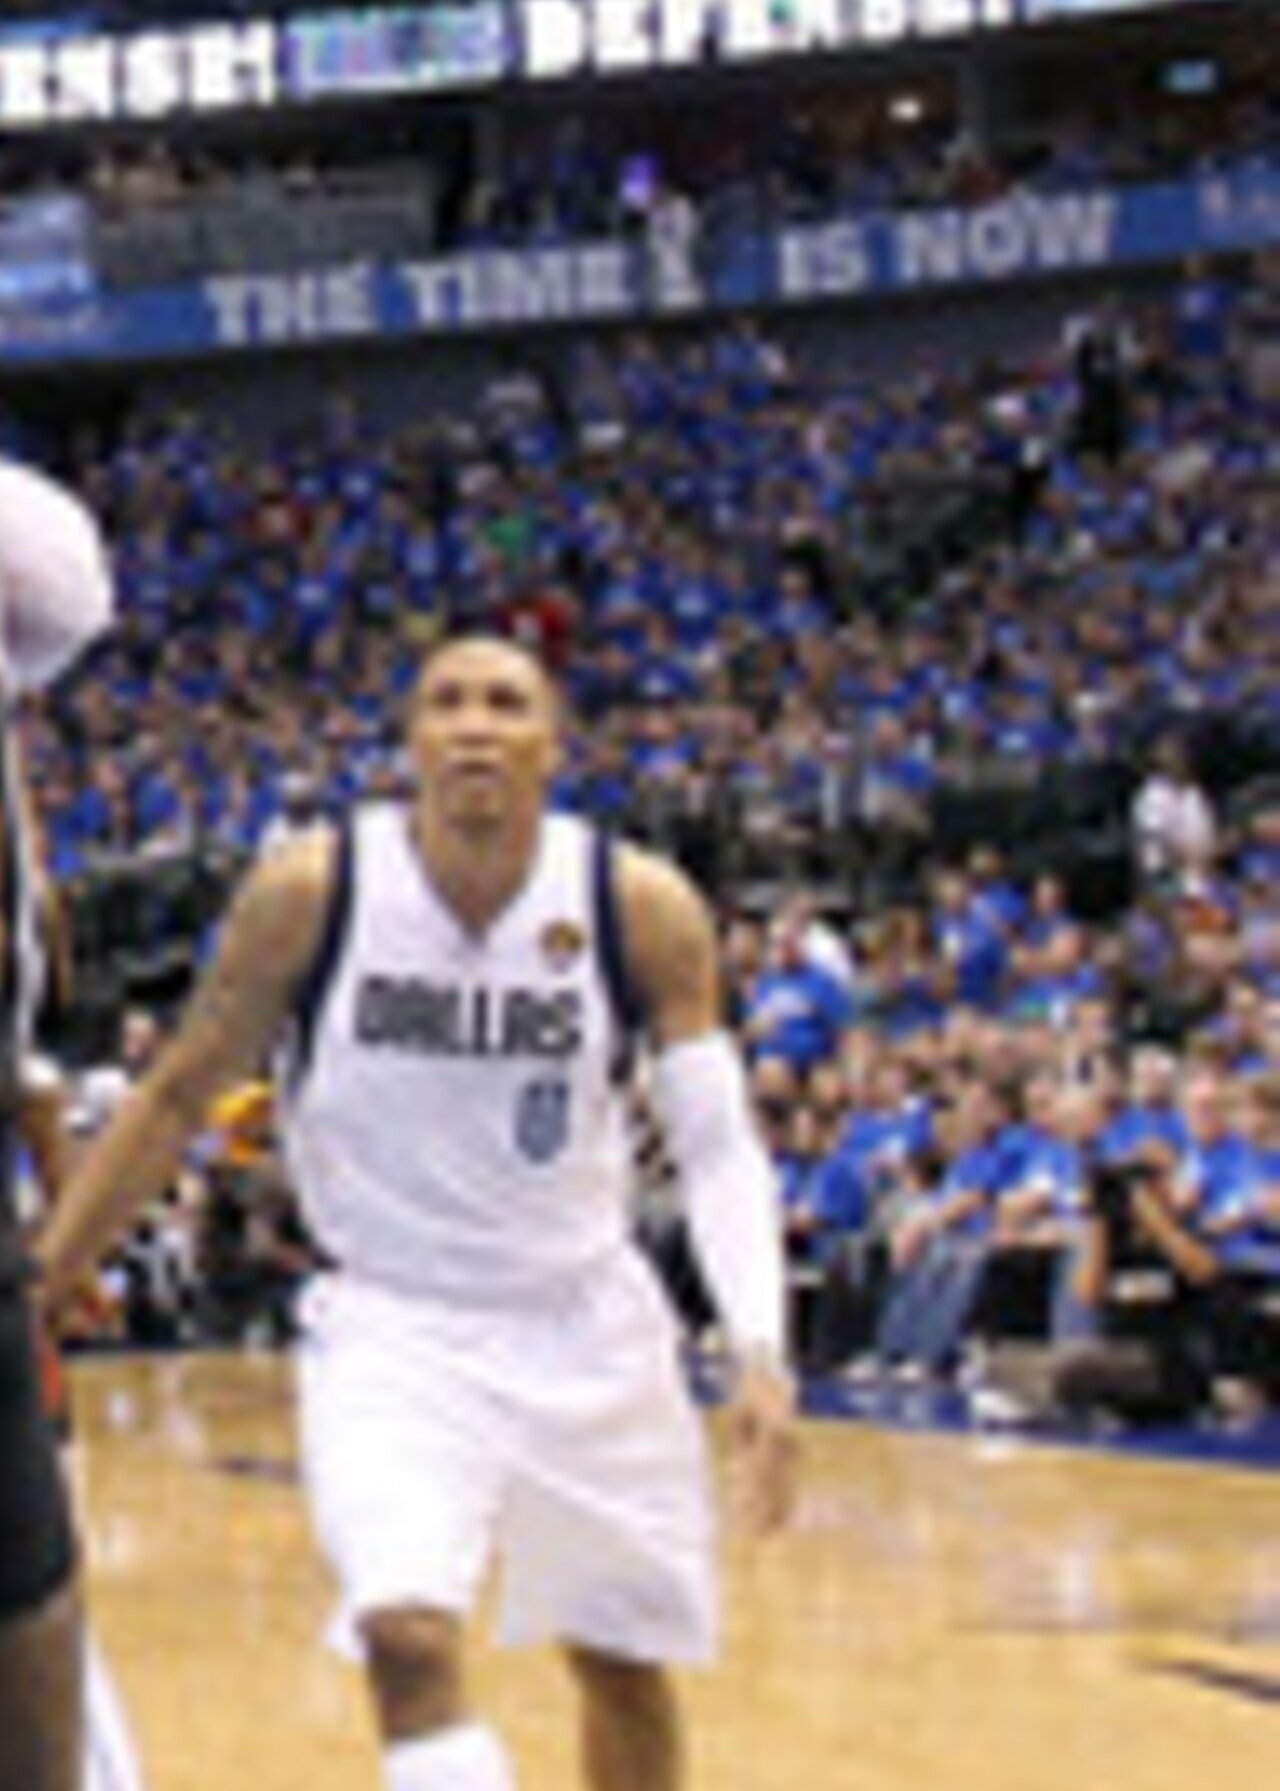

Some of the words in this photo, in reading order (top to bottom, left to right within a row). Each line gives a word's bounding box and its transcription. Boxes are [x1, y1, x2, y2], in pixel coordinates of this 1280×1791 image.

[207, 260, 377, 341] THE
[409, 236, 633, 327] TIME
[779, 219, 868, 298] IS
[897, 193, 1117, 281] NOW
[355, 976, 582, 1059] DALLAS
